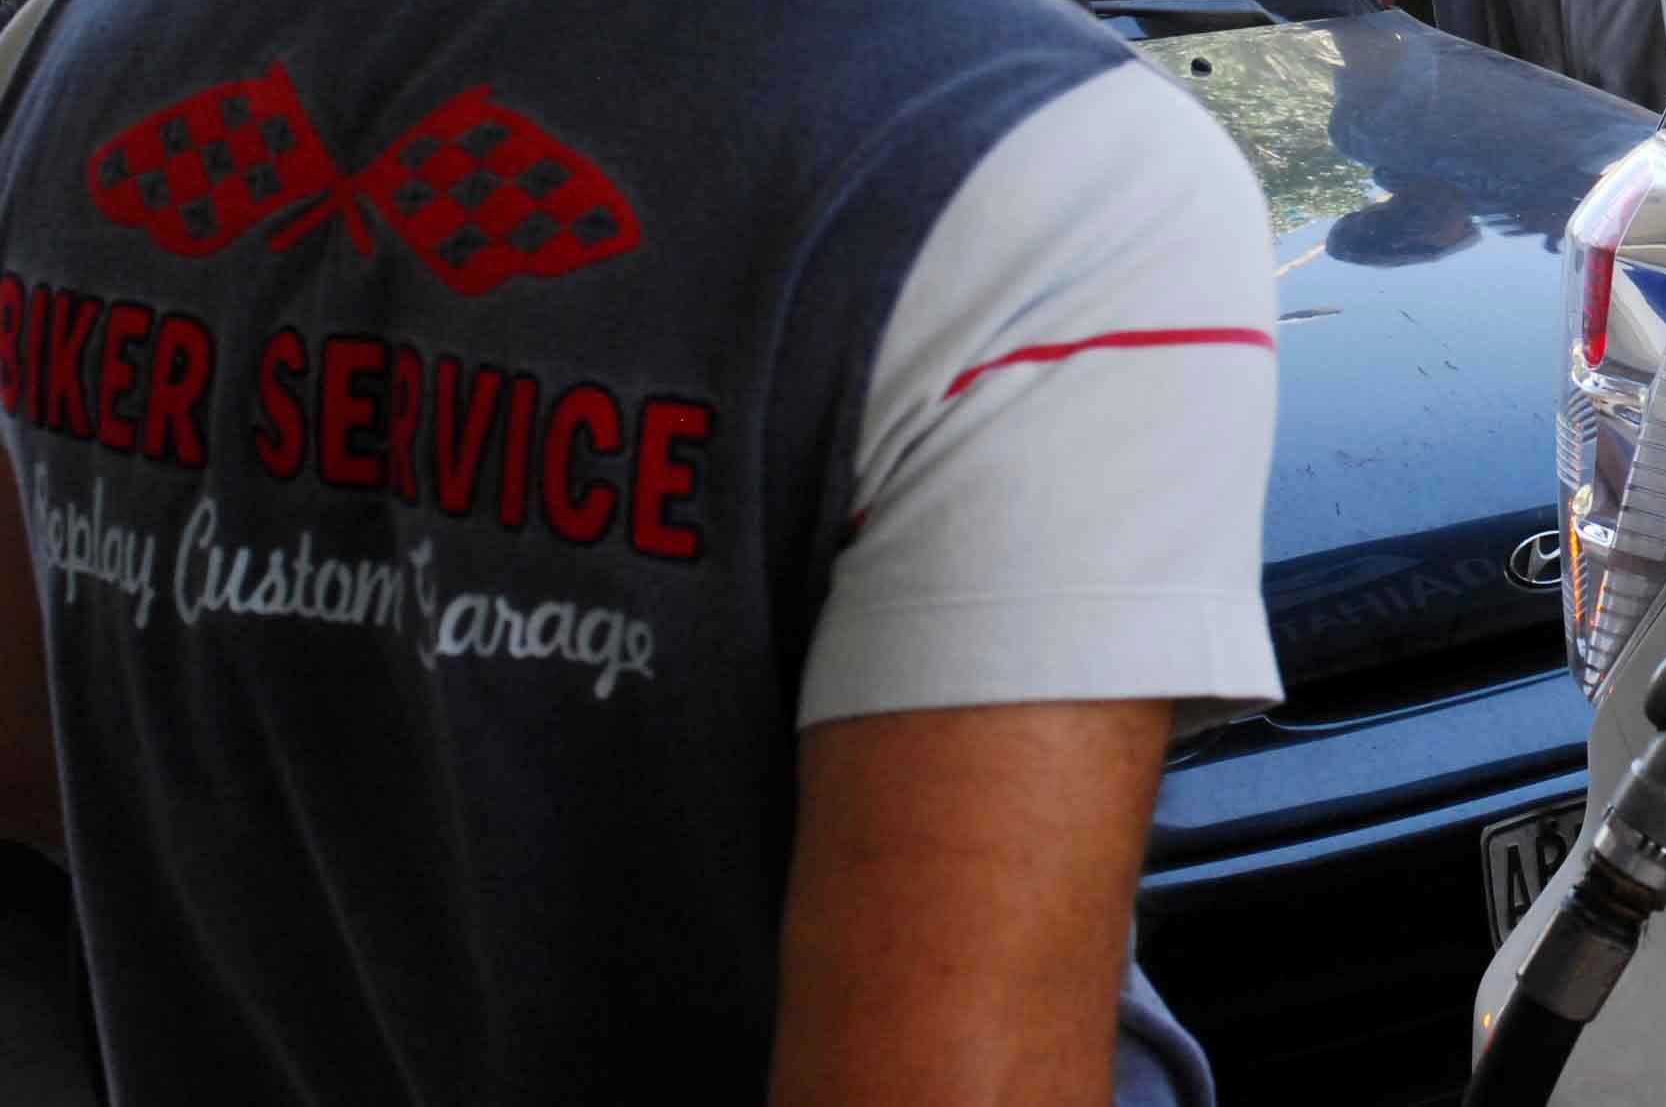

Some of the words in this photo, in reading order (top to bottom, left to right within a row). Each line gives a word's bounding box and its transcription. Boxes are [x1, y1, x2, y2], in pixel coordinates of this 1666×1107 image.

[0, 272, 213, 470] BIKER
[255, 329, 713, 559] SERVICE
[174, 499, 402, 624] Custom
